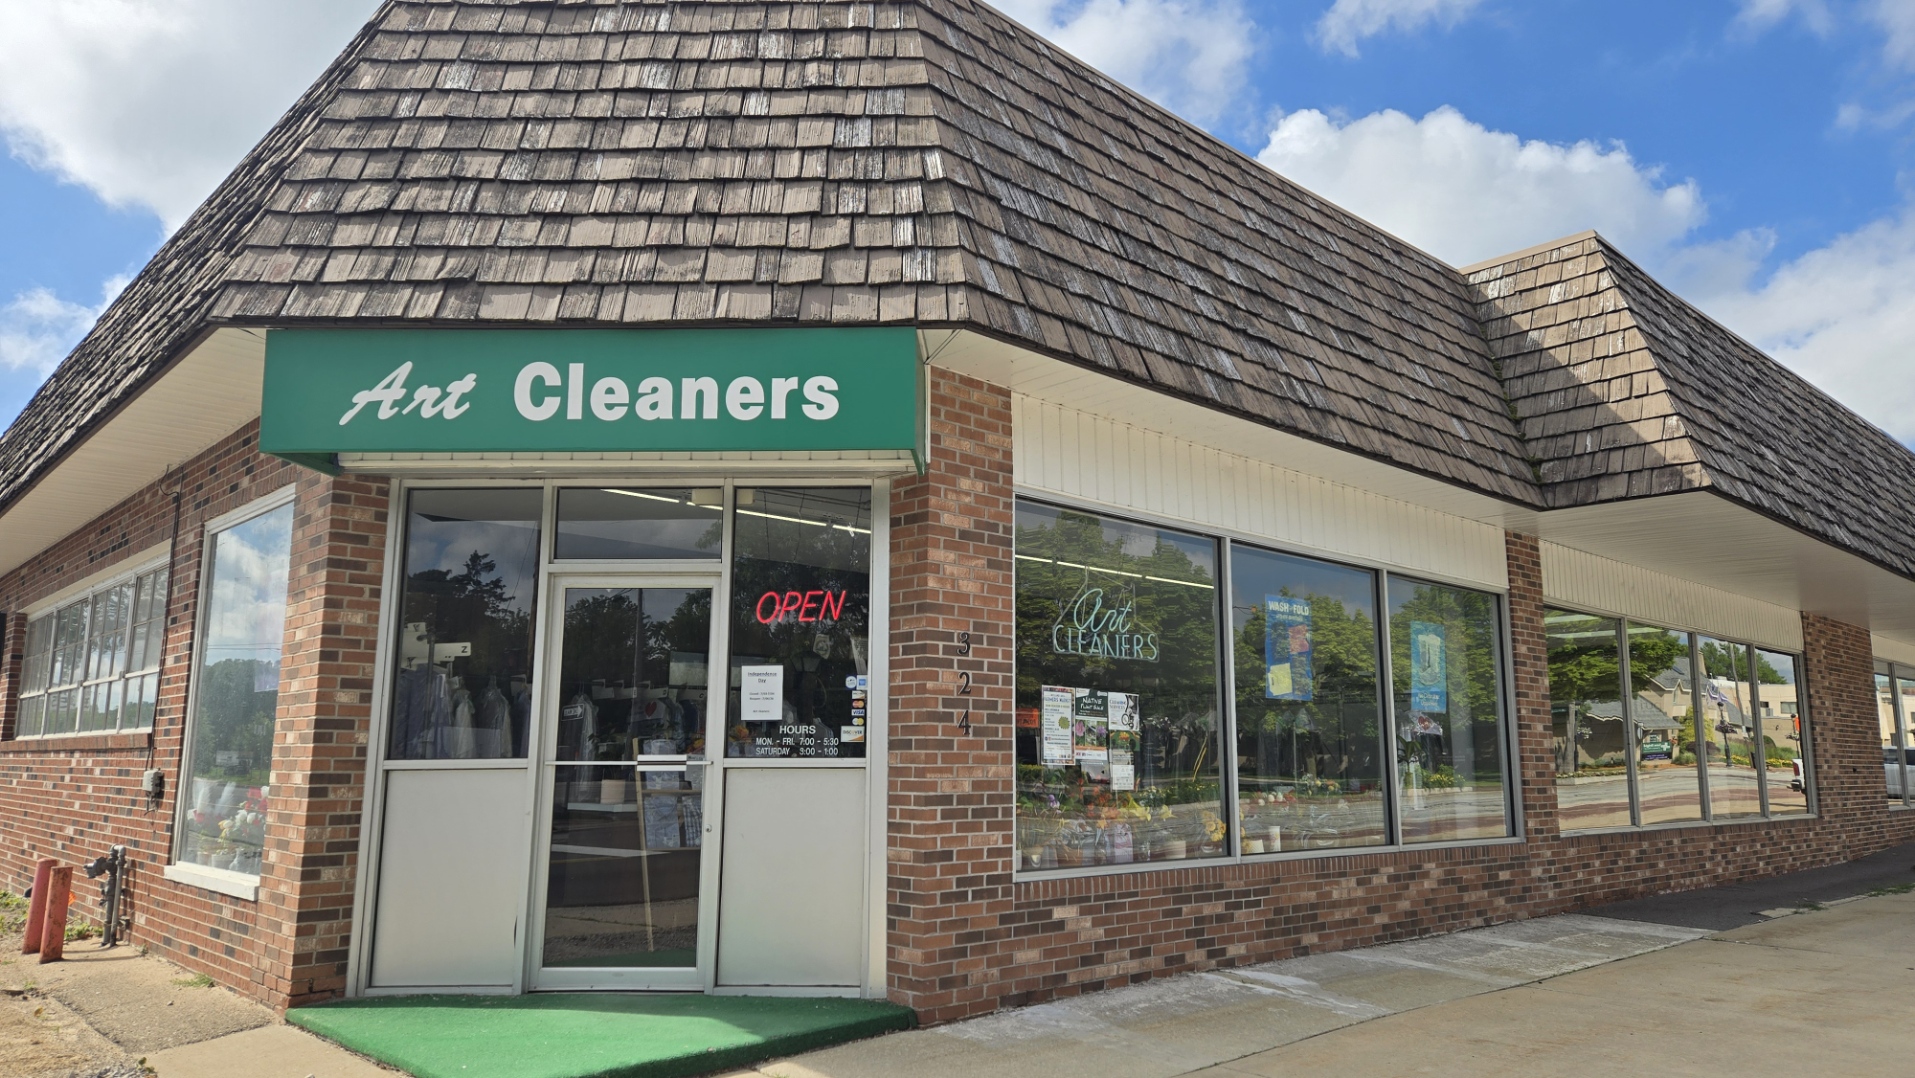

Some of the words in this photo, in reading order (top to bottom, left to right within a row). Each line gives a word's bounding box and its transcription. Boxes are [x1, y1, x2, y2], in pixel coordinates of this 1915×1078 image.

[339, 360, 477, 426] Art
[513, 361, 840, 422] Cleaners
[756, 590, 847, 624] OPEN
[1074, 588, 1132, 633] Art
[1293, 604, 1310, 616] FOLD
[1054, 624, 1158, 661] CLEANERS
[755, 737, 774, 745] MON.
[799, 737, 815, 745] 7:00
[823, 737, 839, 745] 5:30
[779, 725, 816, 734] HOURS
[755, 747, 790, 755] SATURDAY
[824, 747, 839, 755] 1:00
